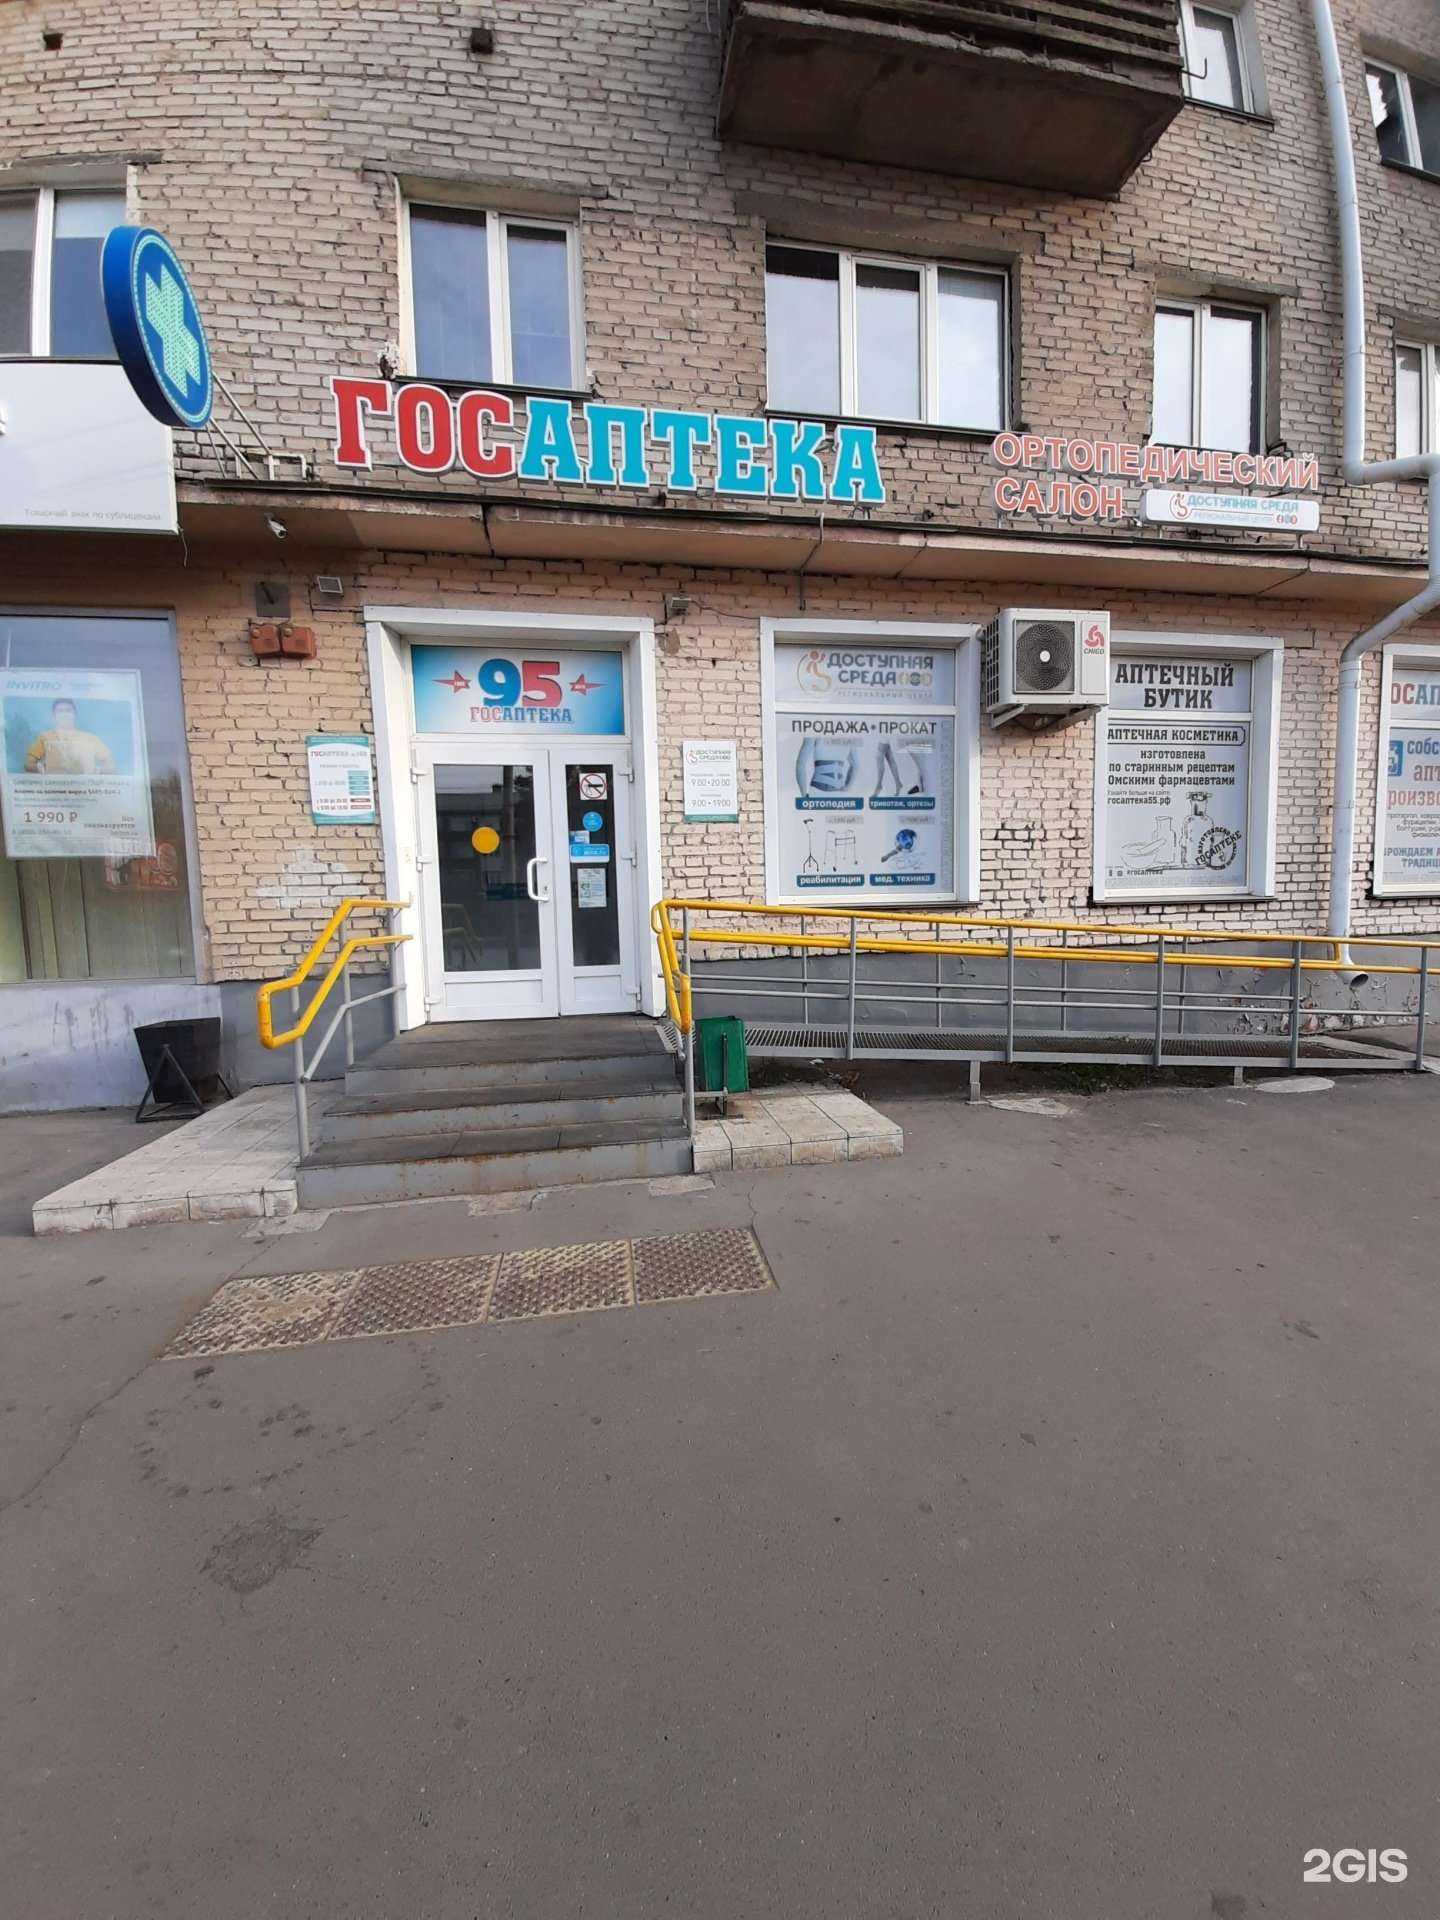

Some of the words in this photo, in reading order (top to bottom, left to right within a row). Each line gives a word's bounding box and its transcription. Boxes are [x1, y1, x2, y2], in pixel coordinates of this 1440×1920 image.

[329, 375, 887, 505] ГОСАПТЕКА
[992, 431, 1320, 491] ОРТОПЕДИЧЕСКИЙ
[995, 477, 1125, 519] САЛОН
[1187, 494, 1258, 510] ДОСТУПНАЯ
[1260, 498, 1300, 513] СРЕДА
[826, 652, 934, 671] ДОСТУПНАЯ
[478, 657, 563, 708] 95
[838, 670, 897, 687] СРЕДА
[1114, 663, 1234, 687] АПТЕЧНЫЙ
[1143, 688, 1213, 709] БУТИК
[469, 706, 573, 723] ГОСАПТЕКА
[792, 720, 869, 735] ПРОДАЖА
[879, 722, 937, 735] ПРОКАТ
[1107, 728, 1168, 741] АПТЕЧНАЯ
[1171, 729, 1239, 742] КОСМЕТИКА
[1140, 750, 1206, 759] изготовлена
[1109, 764, 1121, 772] по
[1124, 763, 1184, 774] старинным
[1187, 764, 1235, 774] рецептам
[1108, 775, 1155, 785] Омскими
[1158, 775, 1236, 788] фармацевтами
[802, 800, 857, 810] ортопедия
[907, 801, 934, 810] ортезы
[1107, 796, 1172, 806] госаптека55.рф
[37, 811, 65, 823] 990
[1194, 829, 1242, 866] ГОСАПТЕКЕ
[800, 875, 862, 885] реабилитация
[874, 875, 892, 884] мед.
[897, 875, 931, 883] техника
